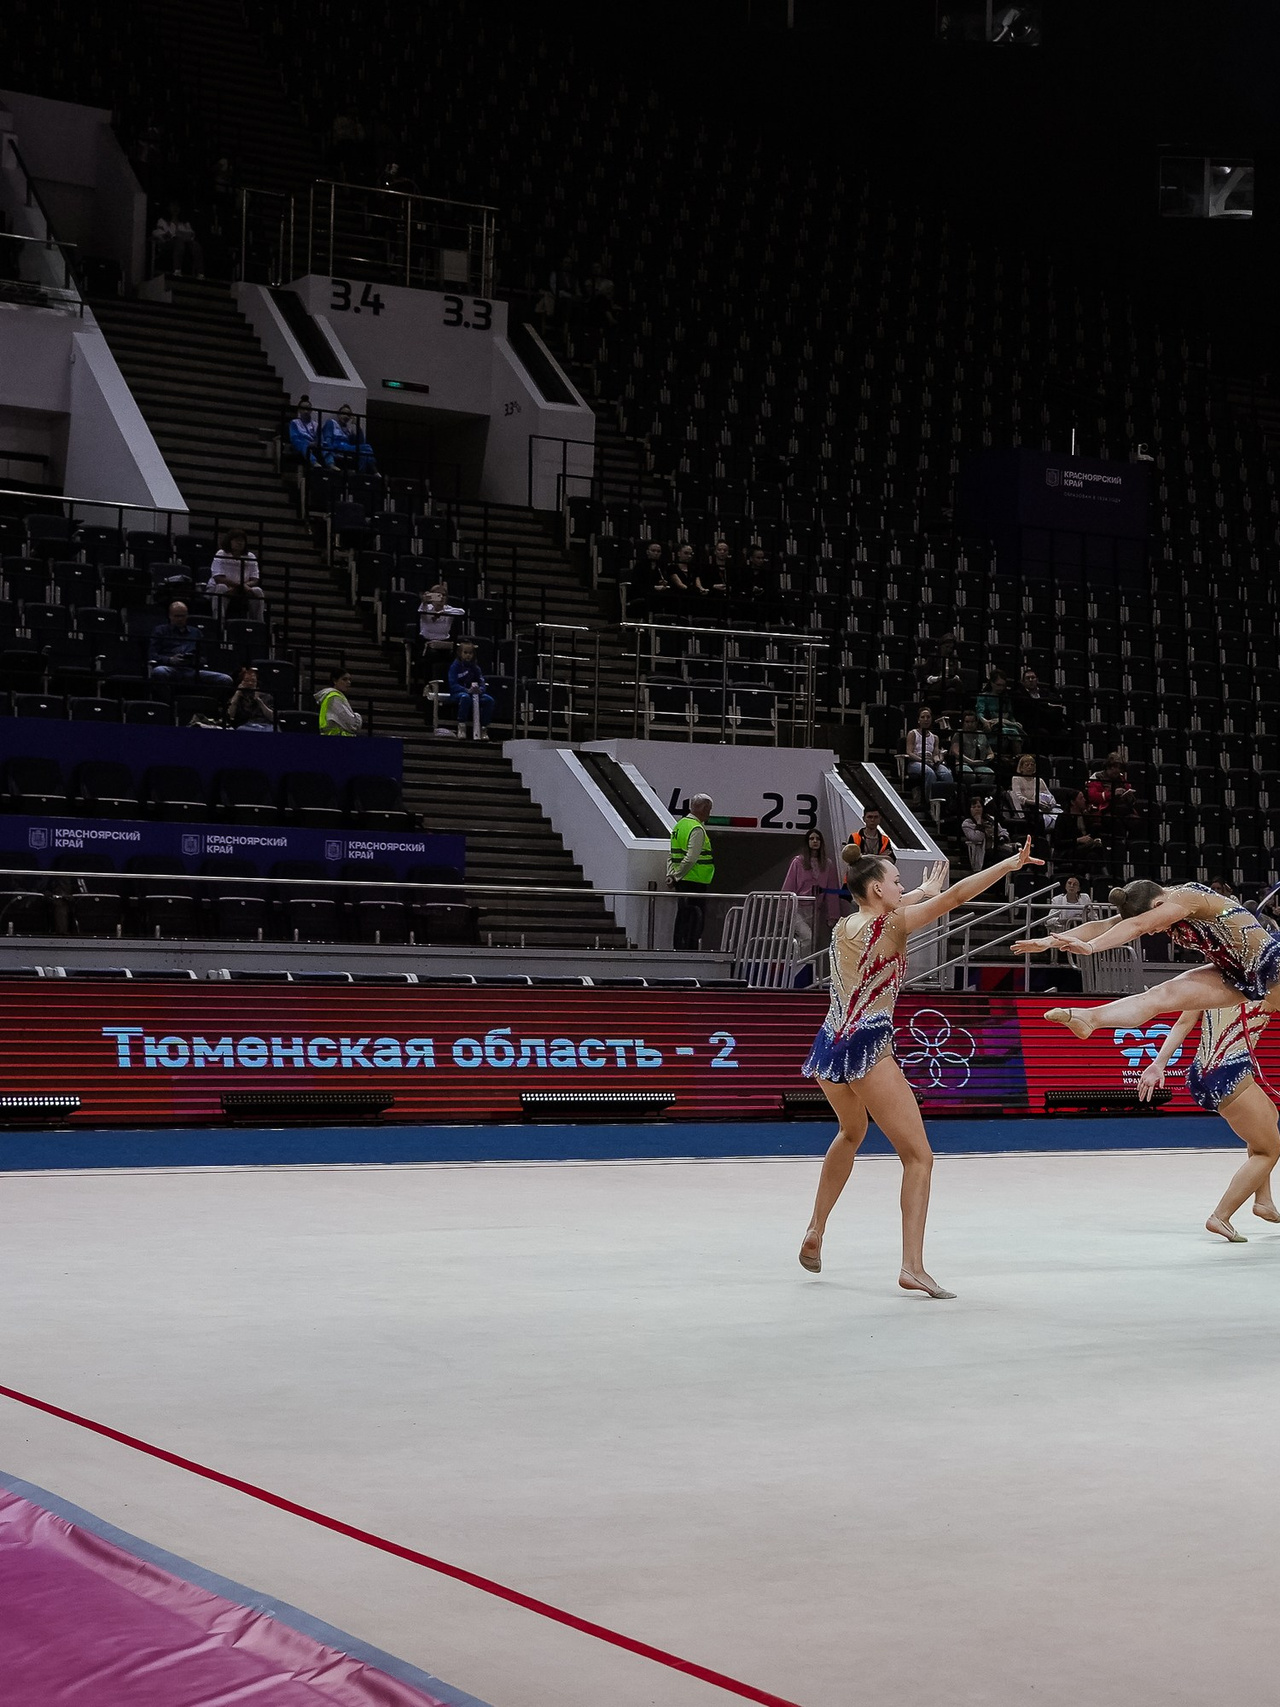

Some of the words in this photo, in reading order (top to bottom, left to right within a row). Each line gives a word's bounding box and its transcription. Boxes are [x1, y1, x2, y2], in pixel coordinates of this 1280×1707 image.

[330, 279, 385, 316] 3.4
[443, 295, 493, 331] 3.3
[1063, 470, 1122, 485] КРАСНОЯРСКИЙ
[1063, 479, 1084, 488] КРАЙ
[760, 792, 818, 830] 2.3
[55, 828, 141, 841] КРАСНОЯРСКИЙ
[206, 834, 288, 847] КРАСНОЯРСКИЙ
[55, 838, 84, 848] КРАЙ
[206, 844, 234, 854] КРАЙ
[348, 840, 426, 853] КРАСНОЯРСКИЙ
[348, 850, 374, 859] КРАЙ
[102, 1026, 436, 1068] Тюменская
[452, 1027, 663, 1068] область
[708, 1031, 739, 1068] 2
